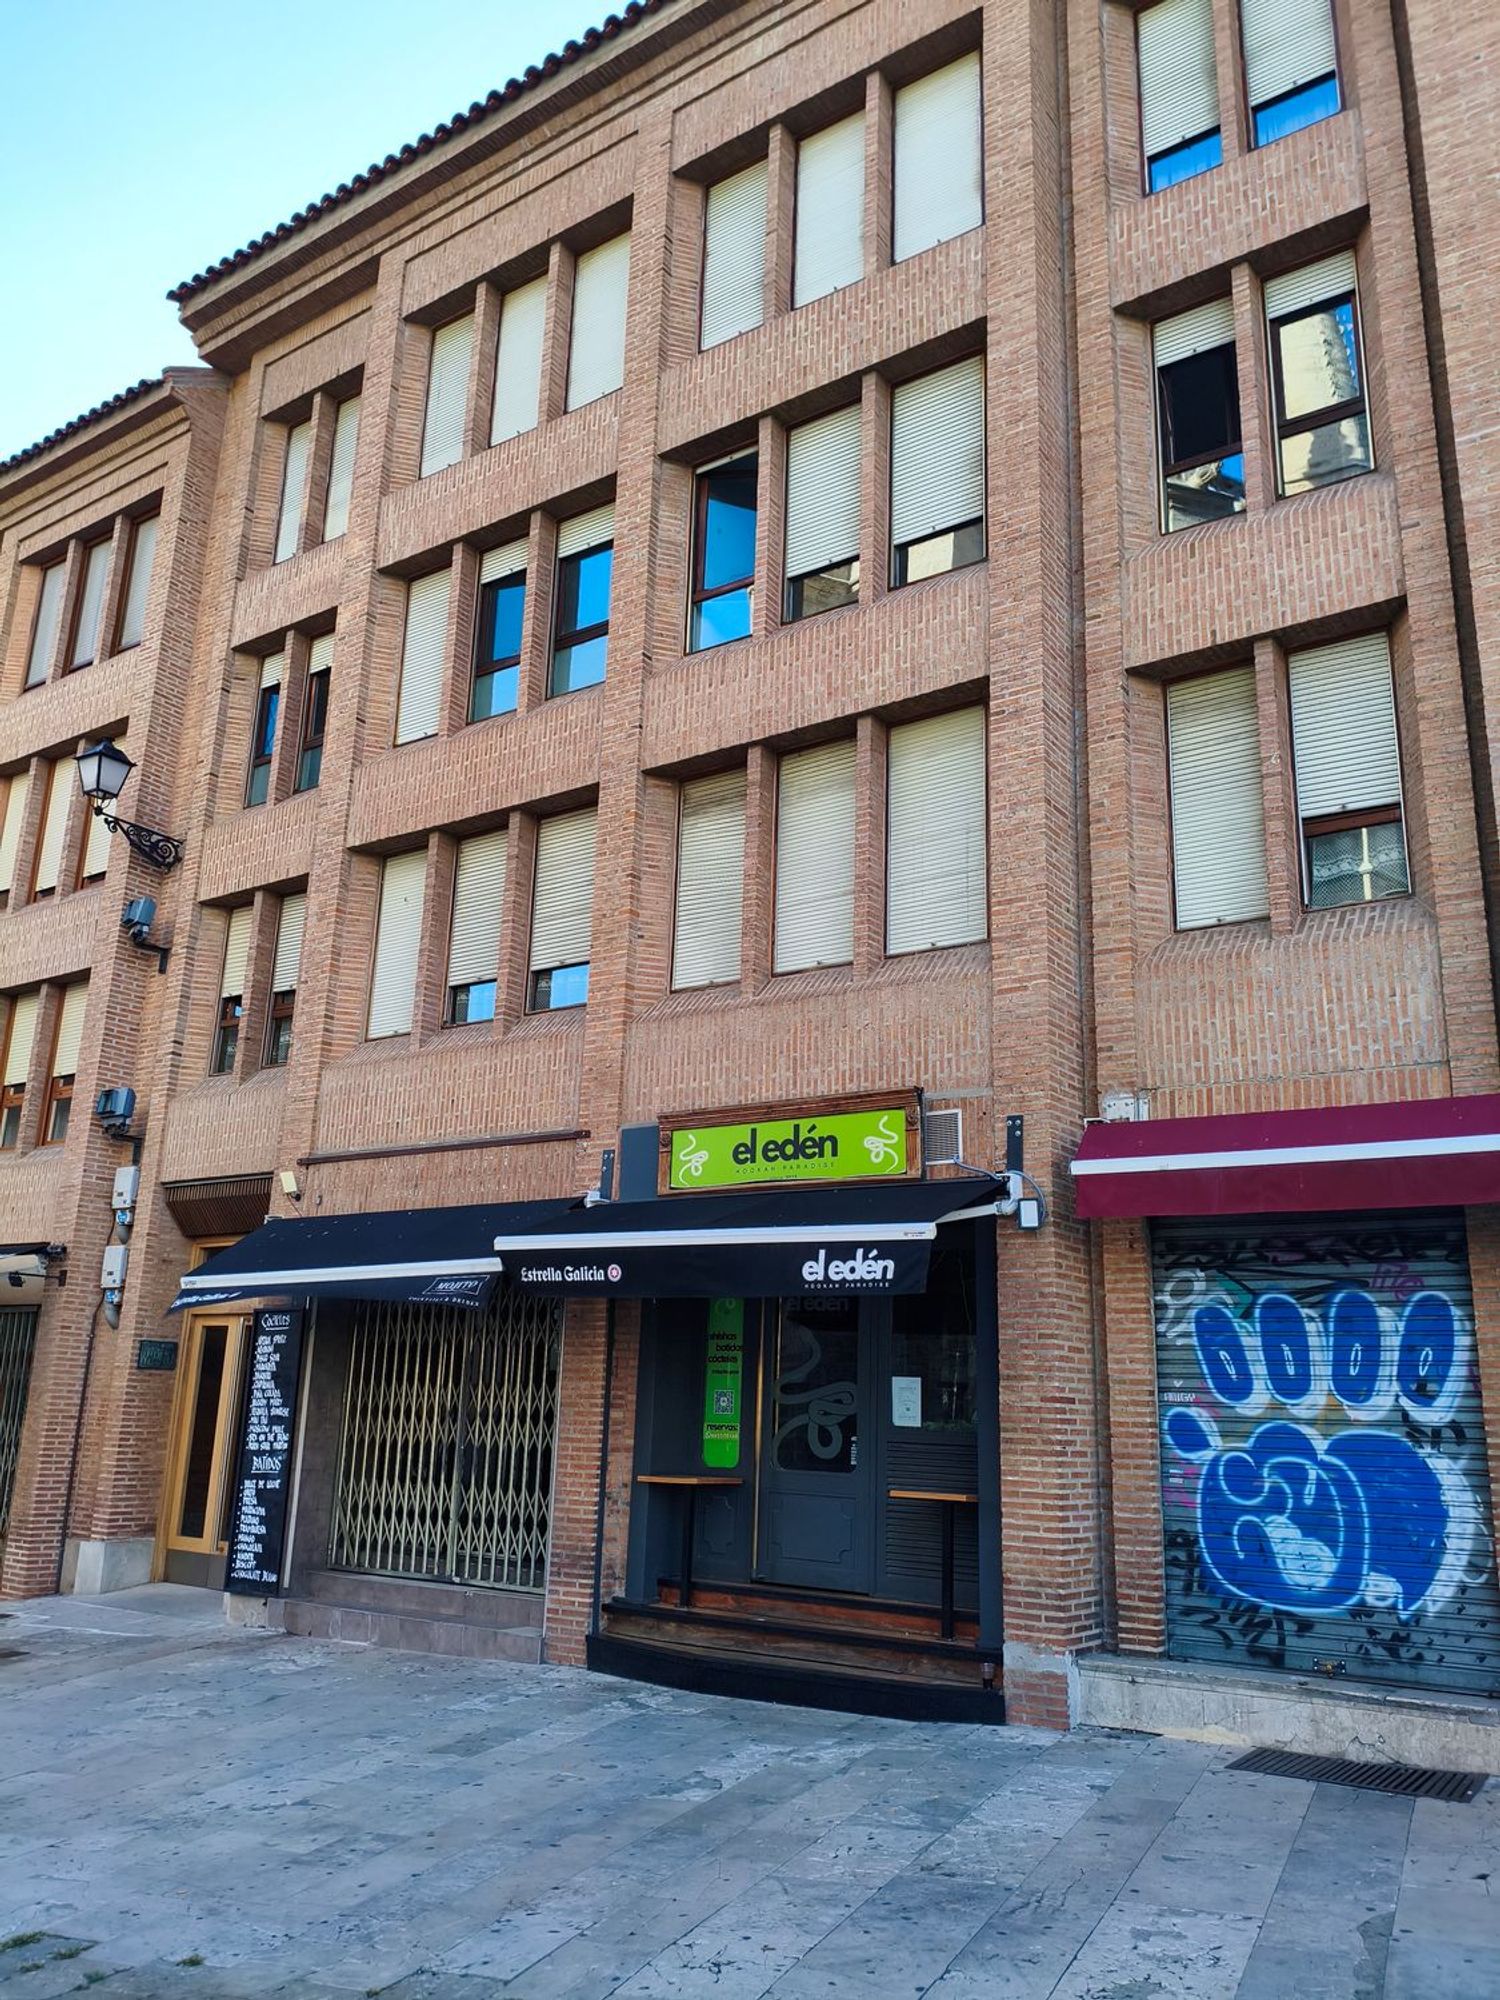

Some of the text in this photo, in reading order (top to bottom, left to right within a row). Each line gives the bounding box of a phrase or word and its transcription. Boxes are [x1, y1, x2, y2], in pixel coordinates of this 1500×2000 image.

[732, 1124, 838, 1165] el edén
[735, 1162, 835, 1175] HOOKAH PARADISE
[802, 1248, 895, 1281] el edén
[521, 1266, 605, 1282] Estrella Galicia
[435, 1280, 479, 1290] MOJITO
